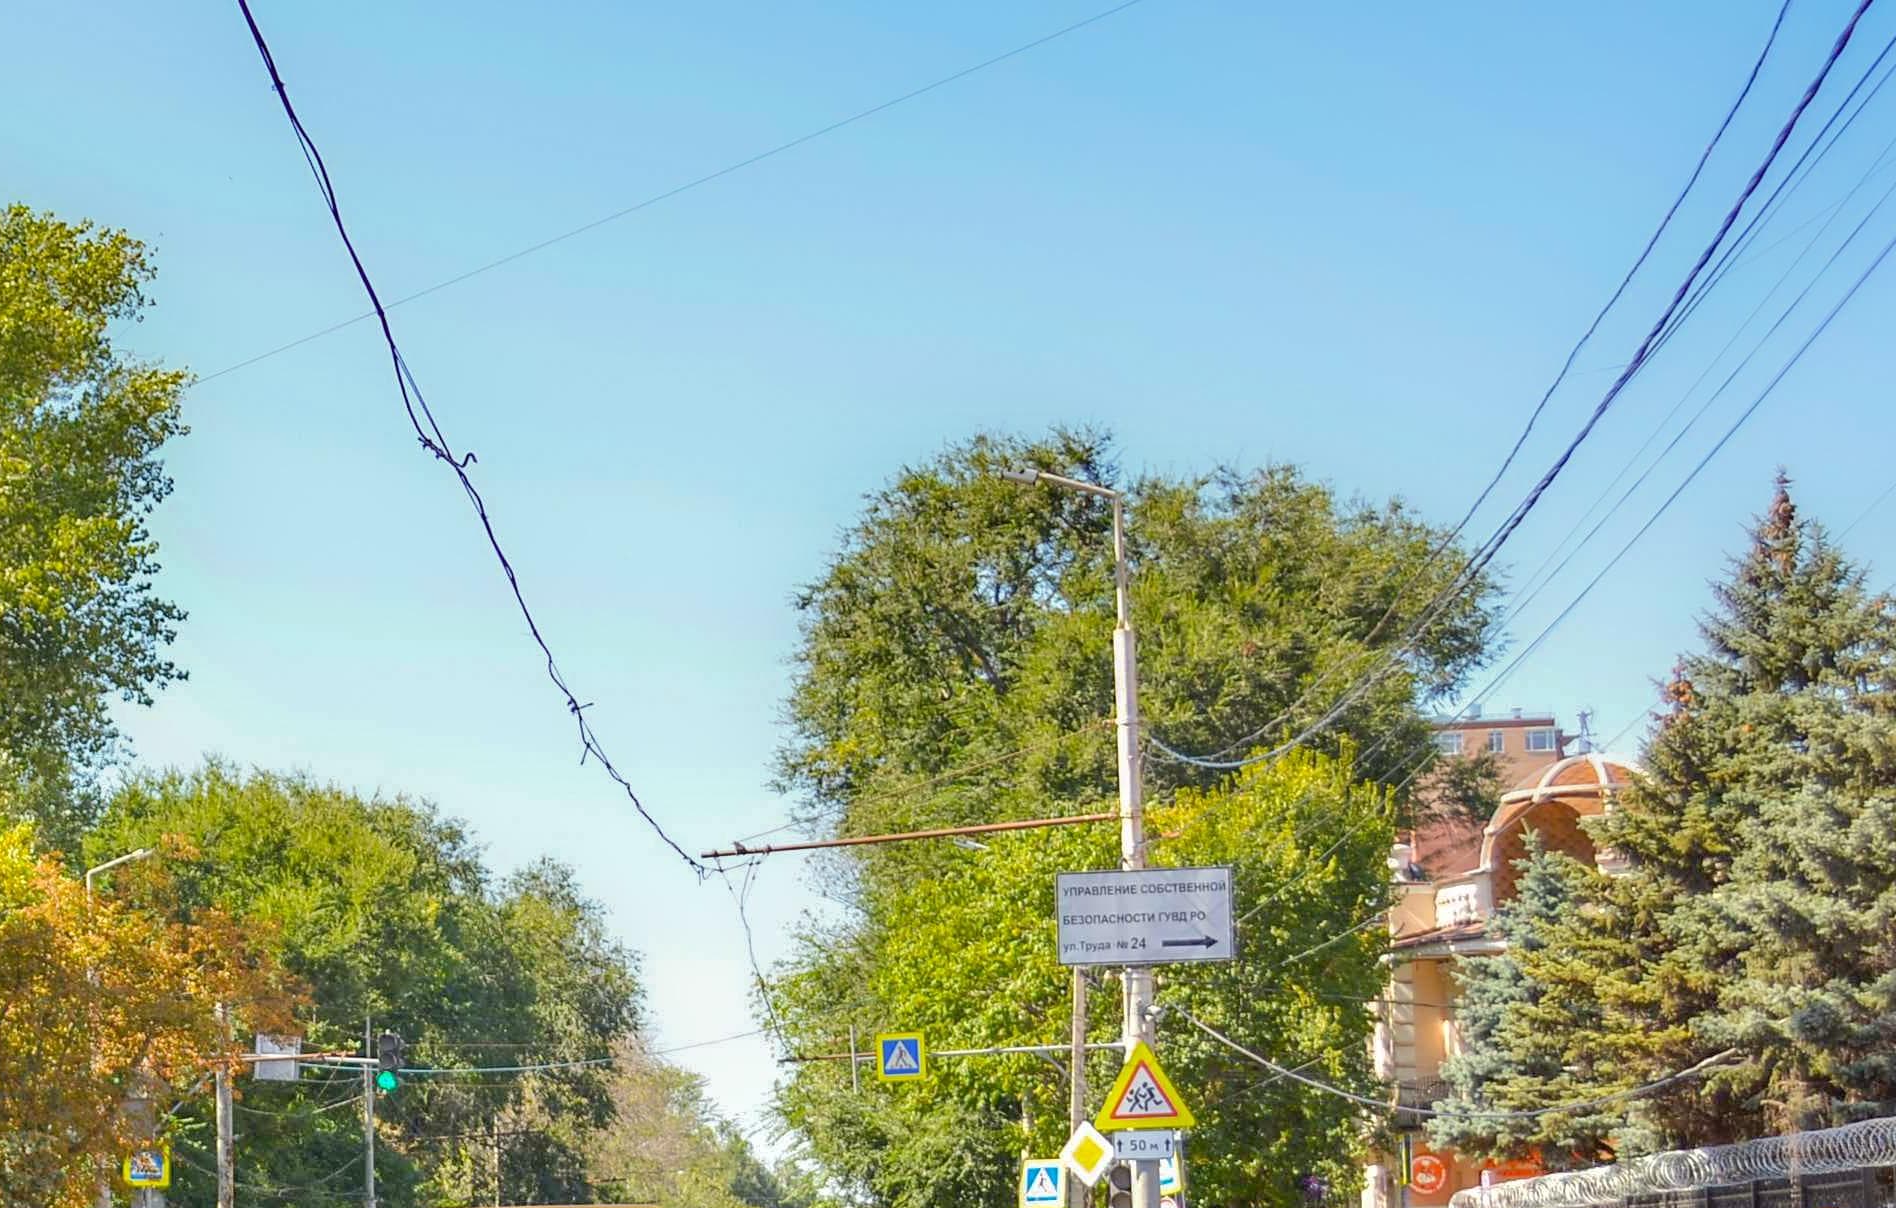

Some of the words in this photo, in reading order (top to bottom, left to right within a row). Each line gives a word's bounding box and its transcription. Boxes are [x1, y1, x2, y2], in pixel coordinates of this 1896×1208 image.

[1063, 884, 1137, 897] УПРАВЛЕНИЕ
[1140, 879, 1226, 894] СОБСТВЕННОЙ
[1063, 912, 1155, 926] БЕЗОПАСНОСТИ
[1158, 911, 1187, 923] ГУВД
[1190, 911, 1206, 921] РО
[1131, 937, 1147, 949] 24
[1130, 1139, 1146, 1151] 50
